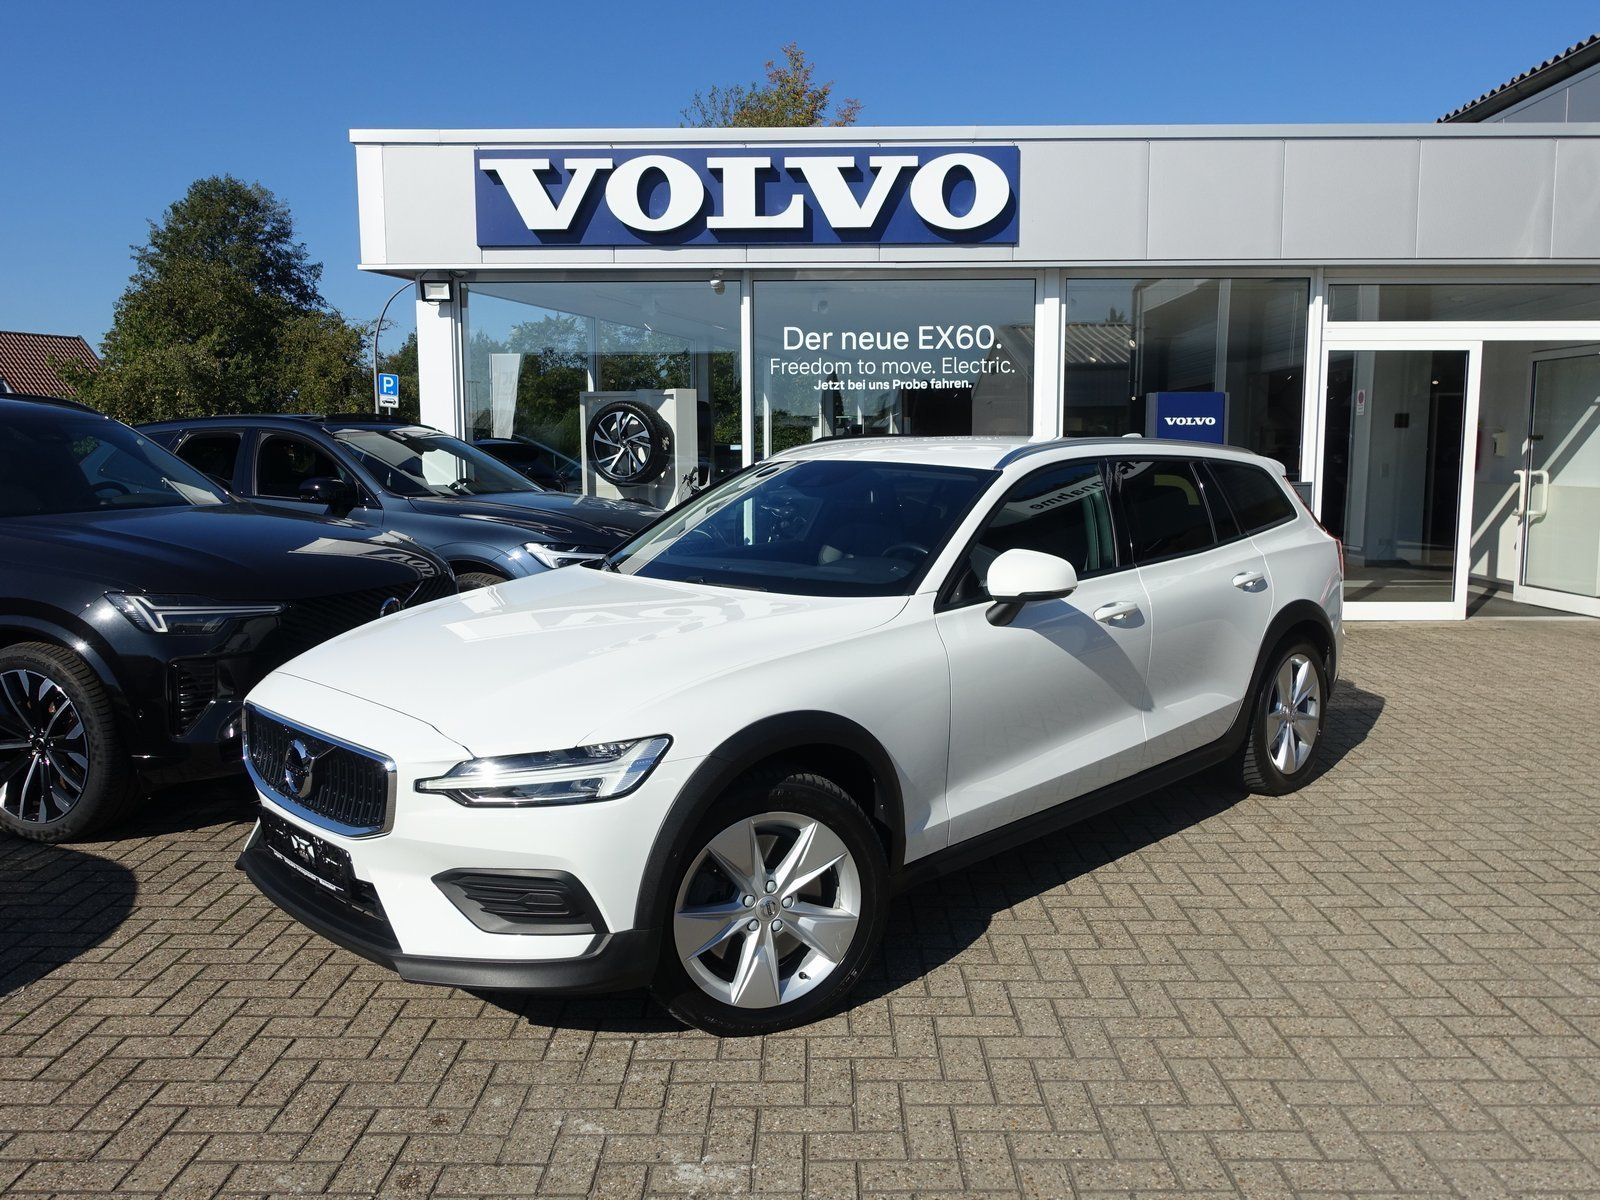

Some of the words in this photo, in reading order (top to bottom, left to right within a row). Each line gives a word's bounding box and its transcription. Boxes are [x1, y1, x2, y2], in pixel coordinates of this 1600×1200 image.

[480, 153, 1010, 232] VOLVO
[783, 326, 833, 351] Der
[841, 331, 909, 351] neue
[918, 324, 1002, 350] EX60.
[770, 357, 852, 375] Freedom
[857, 359, 876, 375] to
[881, 360, 936, 375] move.
[942, 356, 1016, 374] Electric.
[383, 376, 394, 393] P
[813, 379, 846, 391] Jetzt
[847, 379, 866, 390] bei
[868, 381, 890, 390] uns
[892, 378, 928, 390] Probe
[930, 377, 973, 390] fahren.
[1164, 416, 1216, 426] VOLVO
